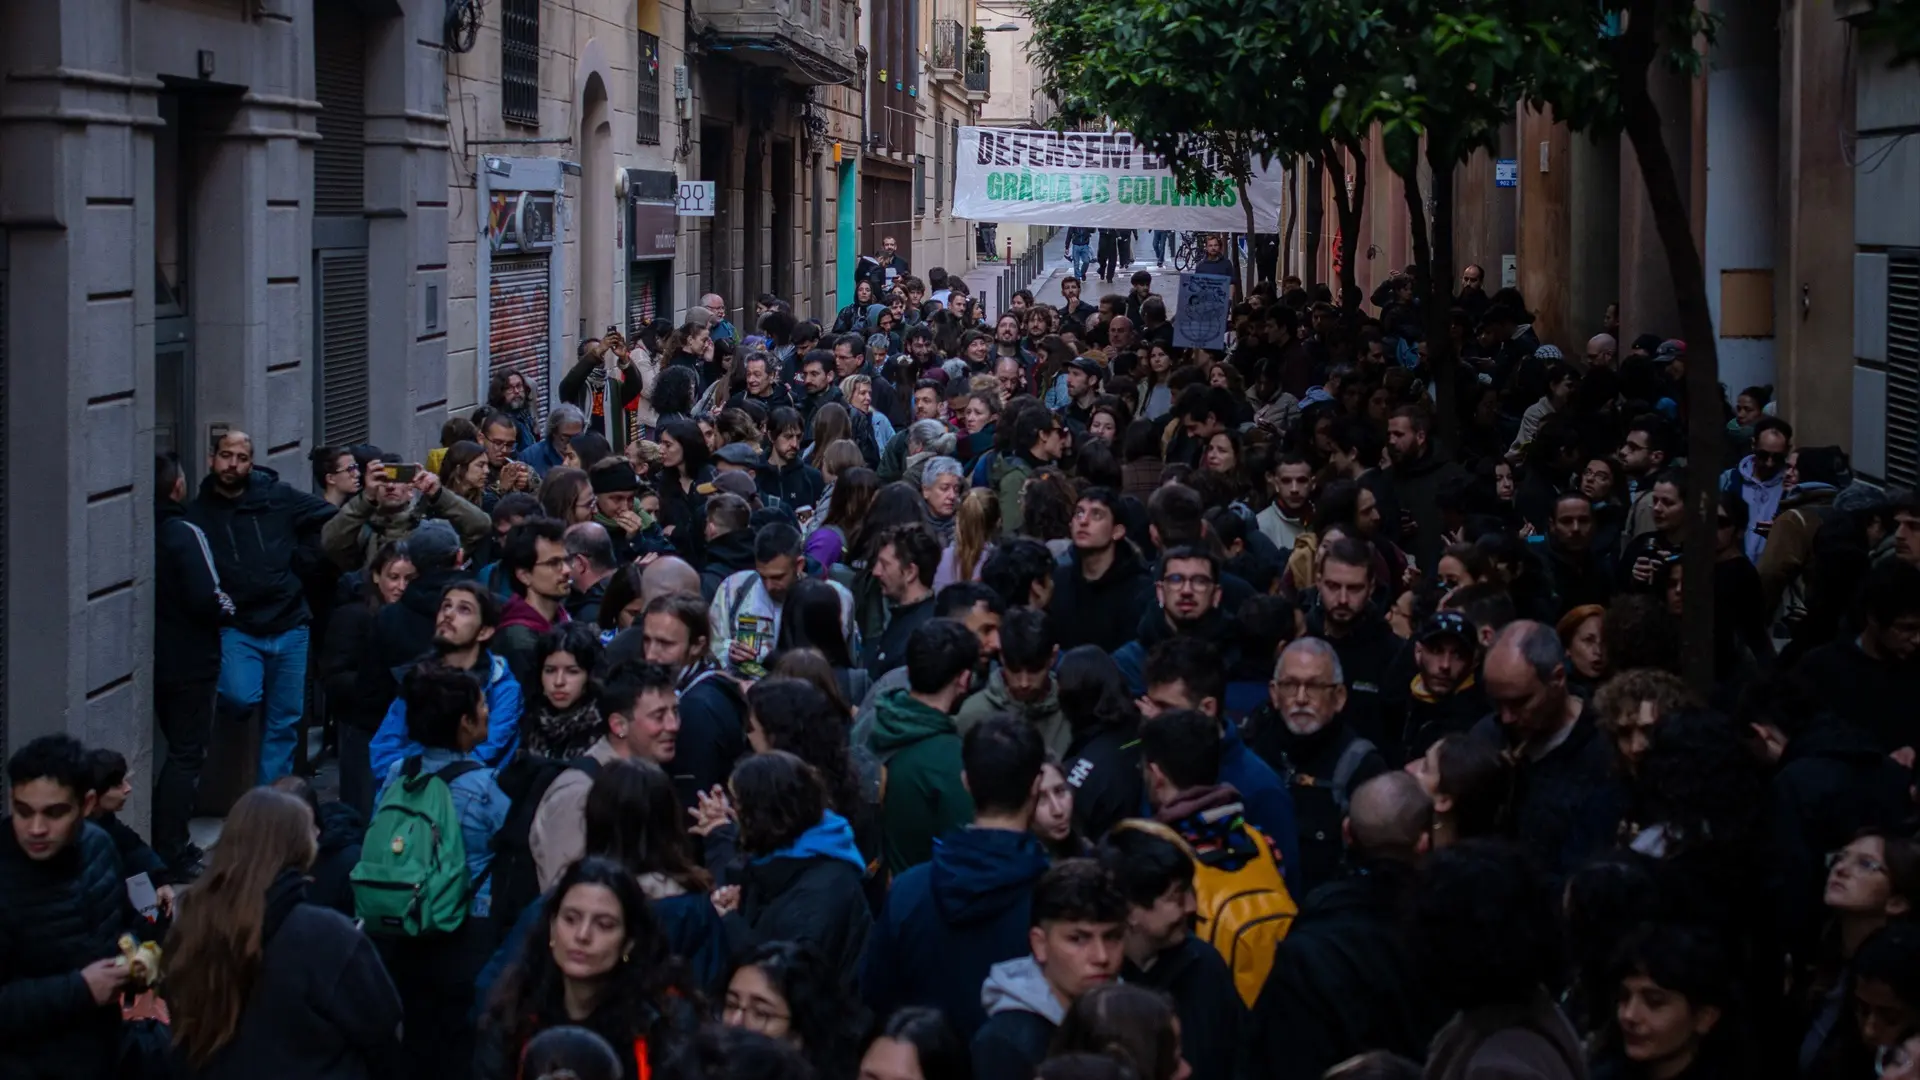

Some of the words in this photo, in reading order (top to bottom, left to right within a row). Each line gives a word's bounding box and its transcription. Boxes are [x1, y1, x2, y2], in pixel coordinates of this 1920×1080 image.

[977, 131, 1131, 169] DEFENSEM
[987, 166, 1072, 201] GRÀCIA
[1081, 174, 1110, 203] VS
[1067, 757, 1094, 788] HH
